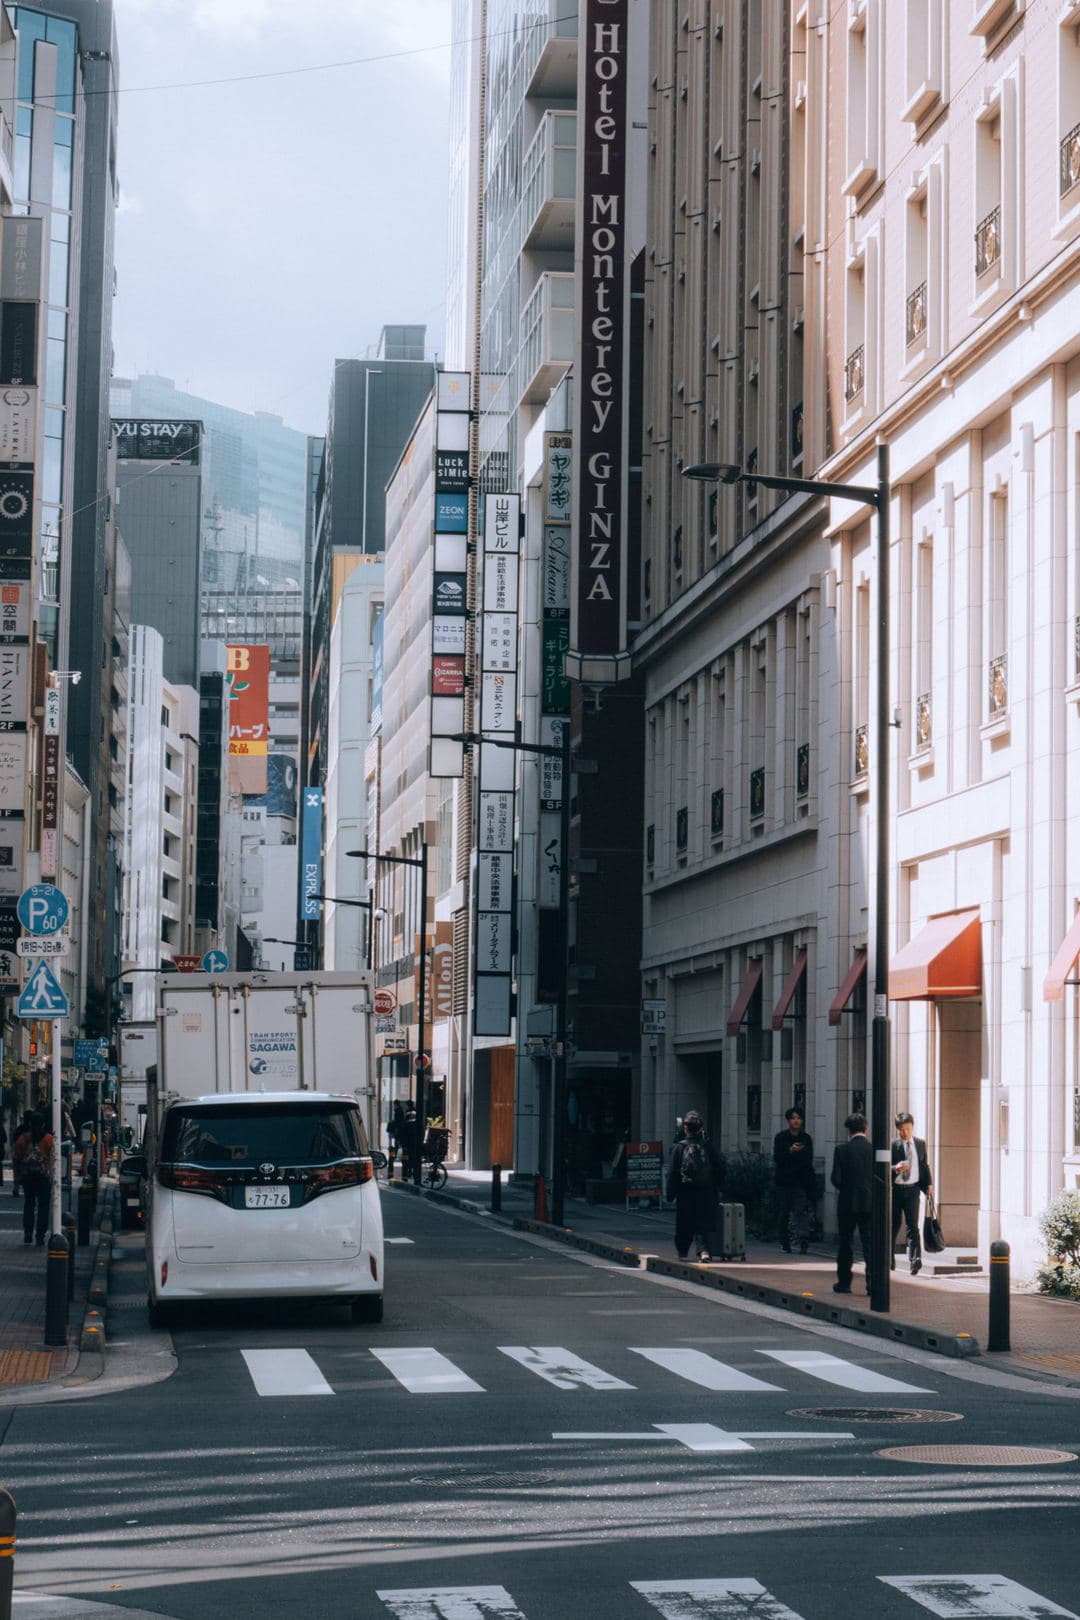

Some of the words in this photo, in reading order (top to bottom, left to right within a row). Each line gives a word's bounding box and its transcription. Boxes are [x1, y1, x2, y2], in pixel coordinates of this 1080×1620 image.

[594, 23, 620, 176] Hotel
[588, 194, 620, 434] Monterey
[141, 424, 183, 437] STAY
[438, 458, 463, 466] Luck
[551, 454, 570, 508] ヤナギ
[440, 506, 464, 514] ZEON
[495, 498, 509, 548] 山岸ビル
[586, 452, 613, 601] GINZA
[3, 604, 17, 632] 空間
[1, 653, 13, 714] HANMI
[545, 640, 557, 702] ギャラリー
[547, 801, 562, 809] 5F
[32, 887, 55, 896] 9-21
[29, 898, 49, 930] P
[43, 915, 58, 930] 60
[250, 1043, 296, 1052] SAGAWA
[255, 1194, 287, 1206] 77-76
